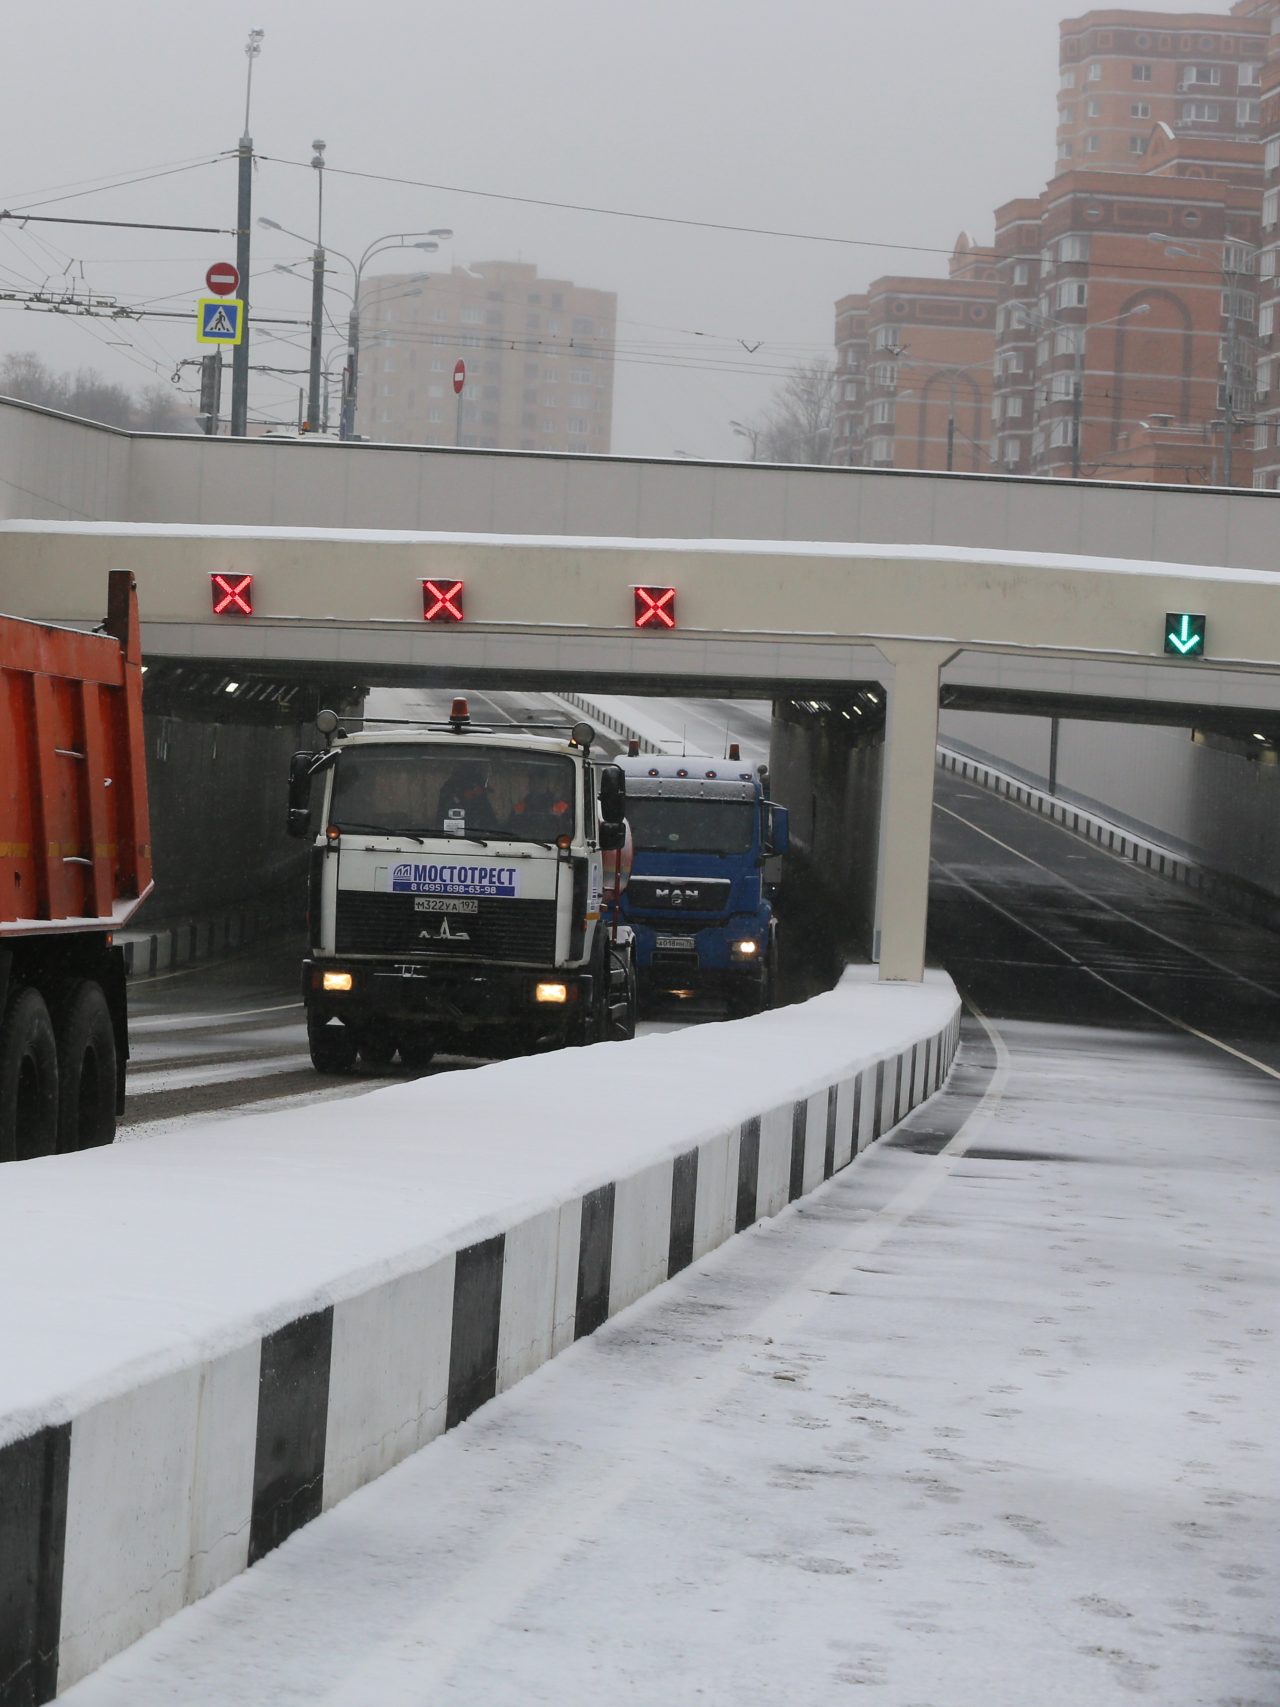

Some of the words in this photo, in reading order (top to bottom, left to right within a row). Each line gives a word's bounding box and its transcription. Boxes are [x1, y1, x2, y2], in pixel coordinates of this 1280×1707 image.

[413, 864, 516, 886] МОСТОТРЕСТ
[410, 883, 417, 891] 8
[419, 883, 444, 893] (495)
[446, 885, 497, 894] 698-63-98
[656, 889, 699, 898] MAN
[461, 901, 475, 909] 197
